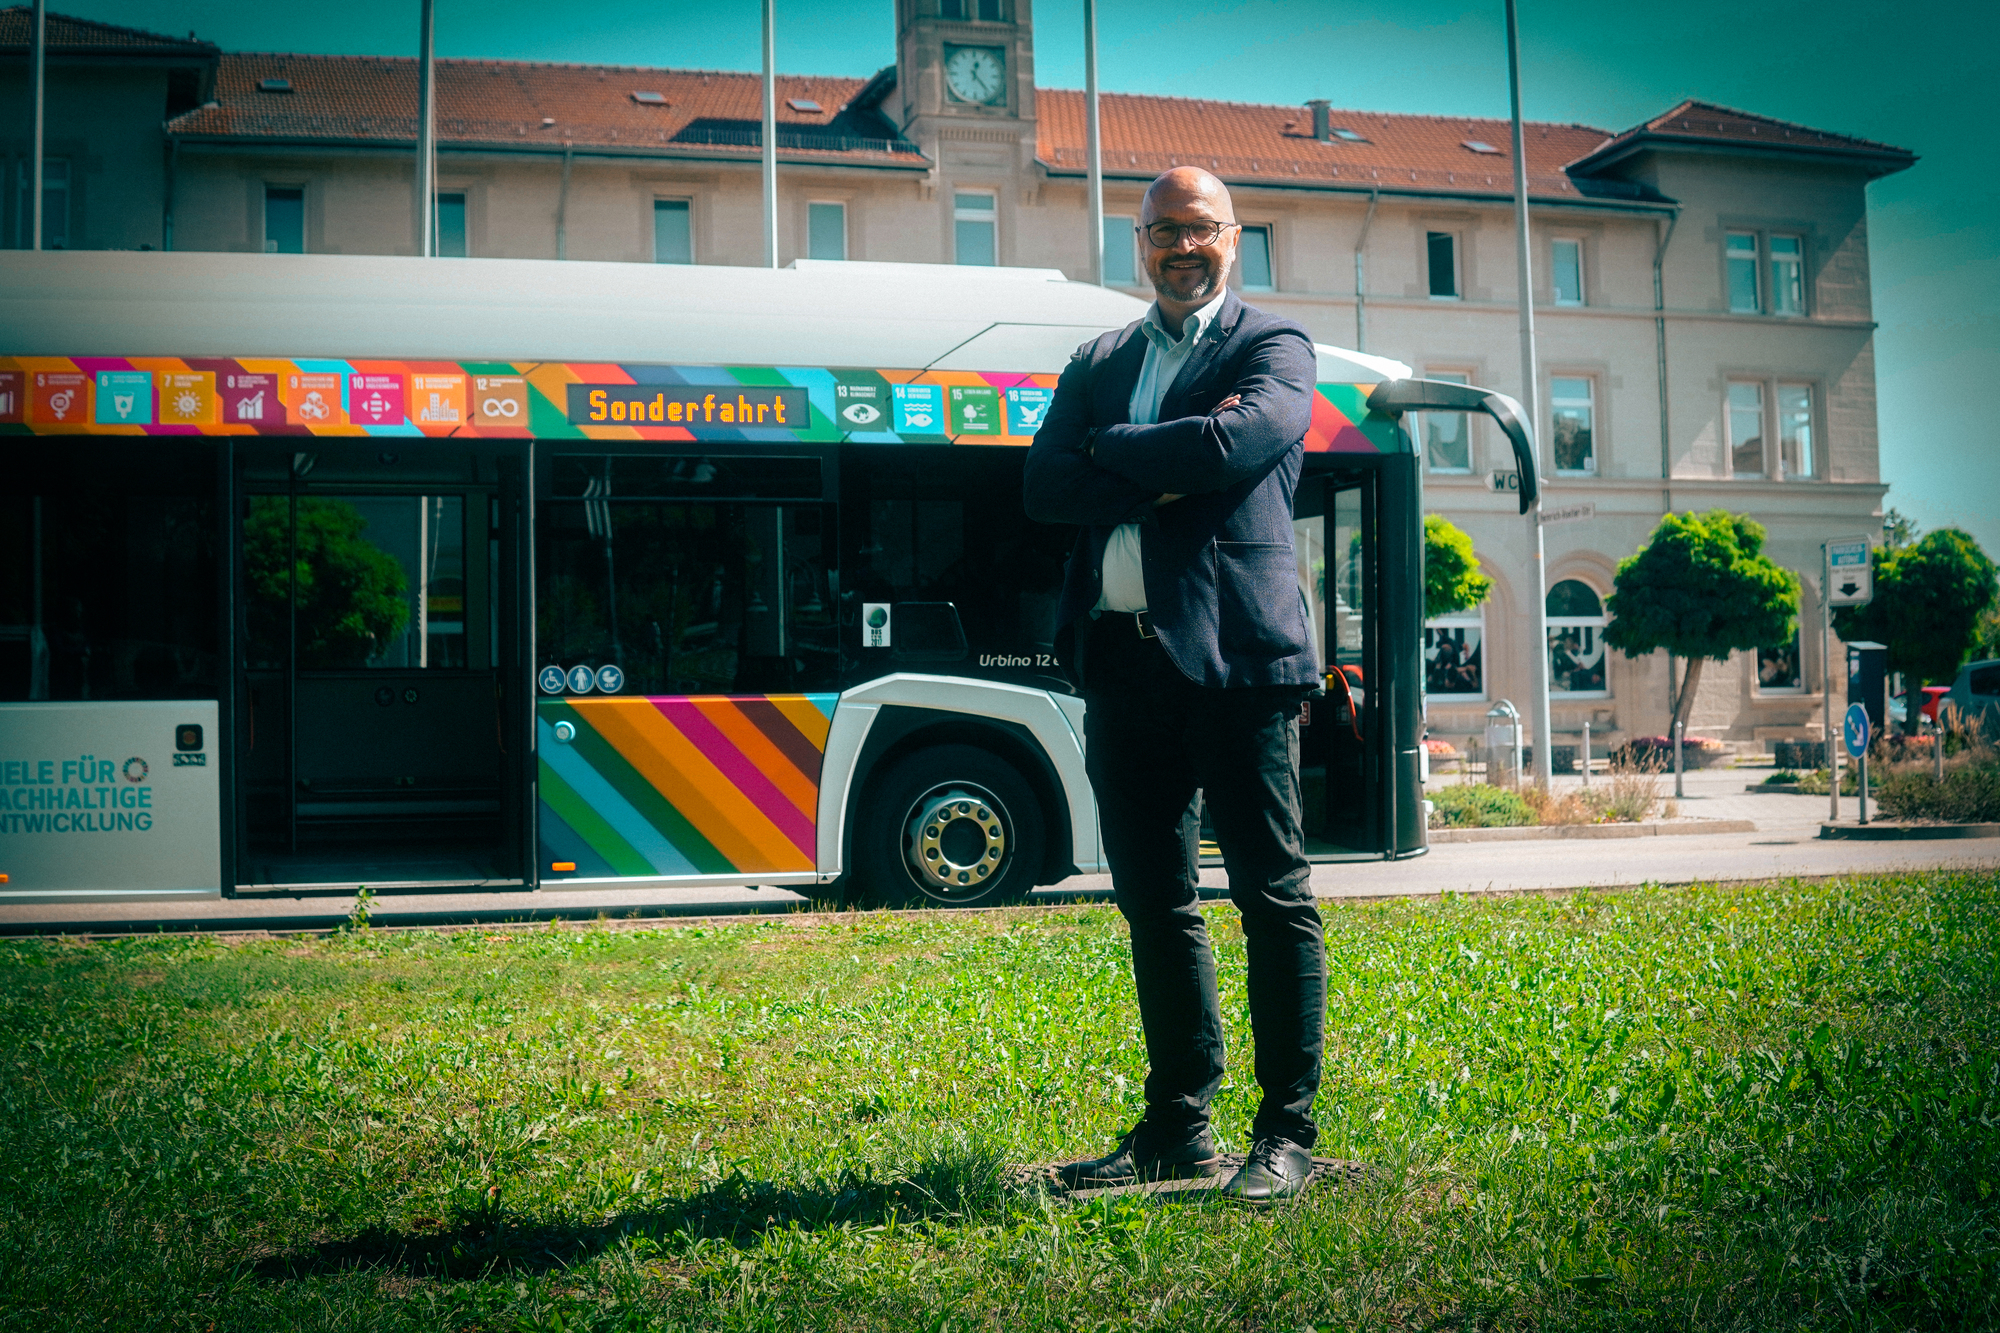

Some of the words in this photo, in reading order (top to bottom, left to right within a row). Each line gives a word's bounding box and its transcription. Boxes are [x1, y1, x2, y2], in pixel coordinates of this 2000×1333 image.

[37, 374, 46, 388] 5
[101, 375, 109, 387] 6
[227, 375, 235, 388] 8
[290, 376, 298, 389] 9
[352, 376, 364, 390] 10
[414, 377, 424, 390] 11
[476, 377, 487, 391] 12
[836, 385, 848, 398] 13
[894, 387, 906, 399] 14
[951, 388, 963, 400] 15
[1008, 389, 1019, 402] 16
[589, 389, 786, 424] Sonderfahrt
[1493, 473, 1519, 490] WC
[979, 654, 1032, 667] Urbino
[1035, 654, 1051, 667] 12
[61, 754, 116, 784] FÜR
